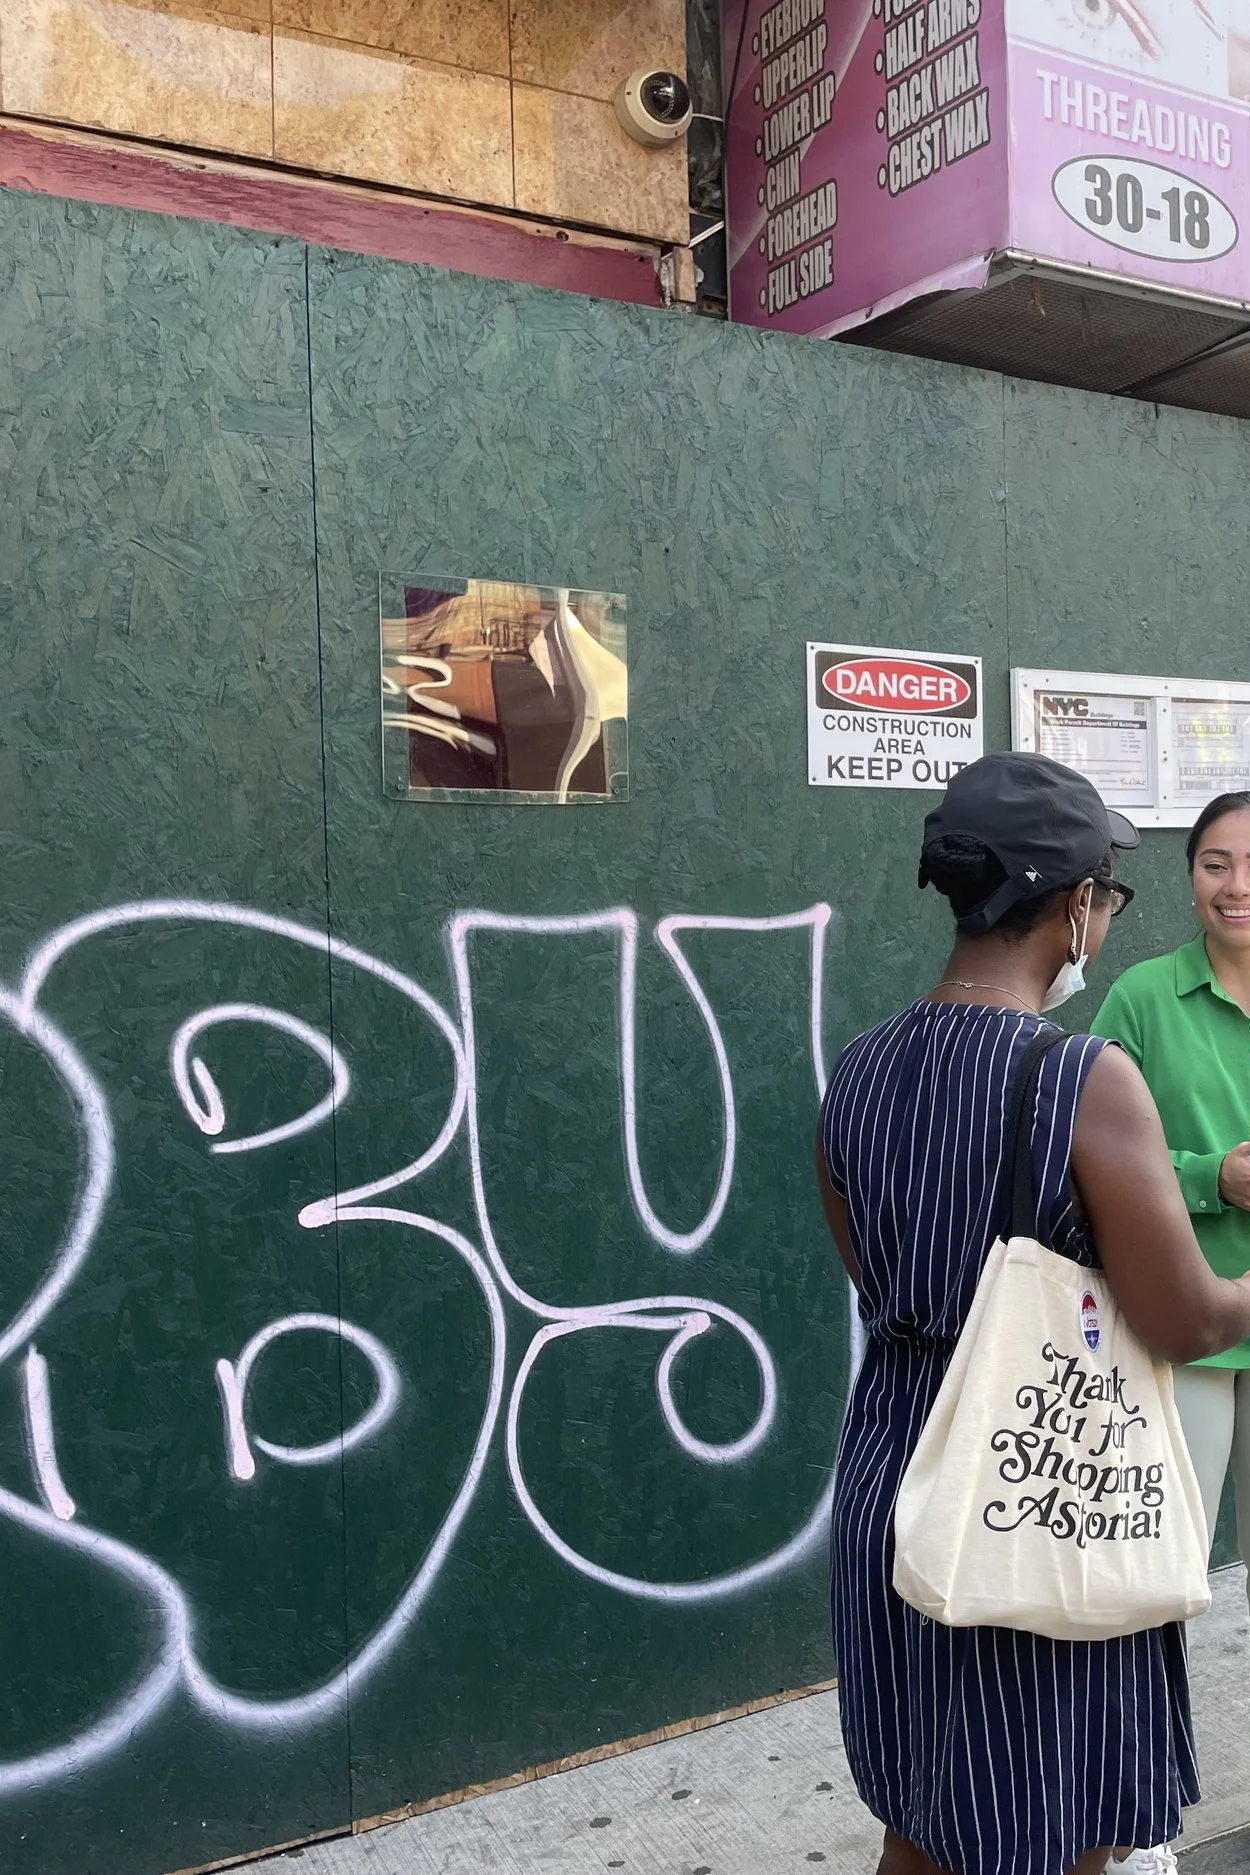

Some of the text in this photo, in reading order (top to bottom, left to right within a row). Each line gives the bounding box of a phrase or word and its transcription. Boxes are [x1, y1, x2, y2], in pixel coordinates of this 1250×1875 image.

[885, 0, 981, 80] HALF ARMS
[764, 74, 835, 162] LOWER LIP
[887, 36, 980, 139] BACK WAX
[1036, 69, 1232, 168] THREADING
[889, 90, 989, 194] CHEST WAX
[766, 150, 800, 211] CHIN
[1084, 164, 1210, 250] 30-18
[767, 181, 837, 262] FOREHEAD
[768, 239, 834, 314] FULL SIDE
[836, 668, 958, 703] DANGER
[1042, 696, 1089, 717] NYC
[823, 714, 972, 739] CONSTRUCTION
[873, 737, 926, 756] AREA
[827, 755, 903, 781] KEEP
[1041, 1341, 1140, 1415] Thank
[990, 1428, 1164, 1507] Shopping
[983, 1486, 1162, 1549] Astoria!
